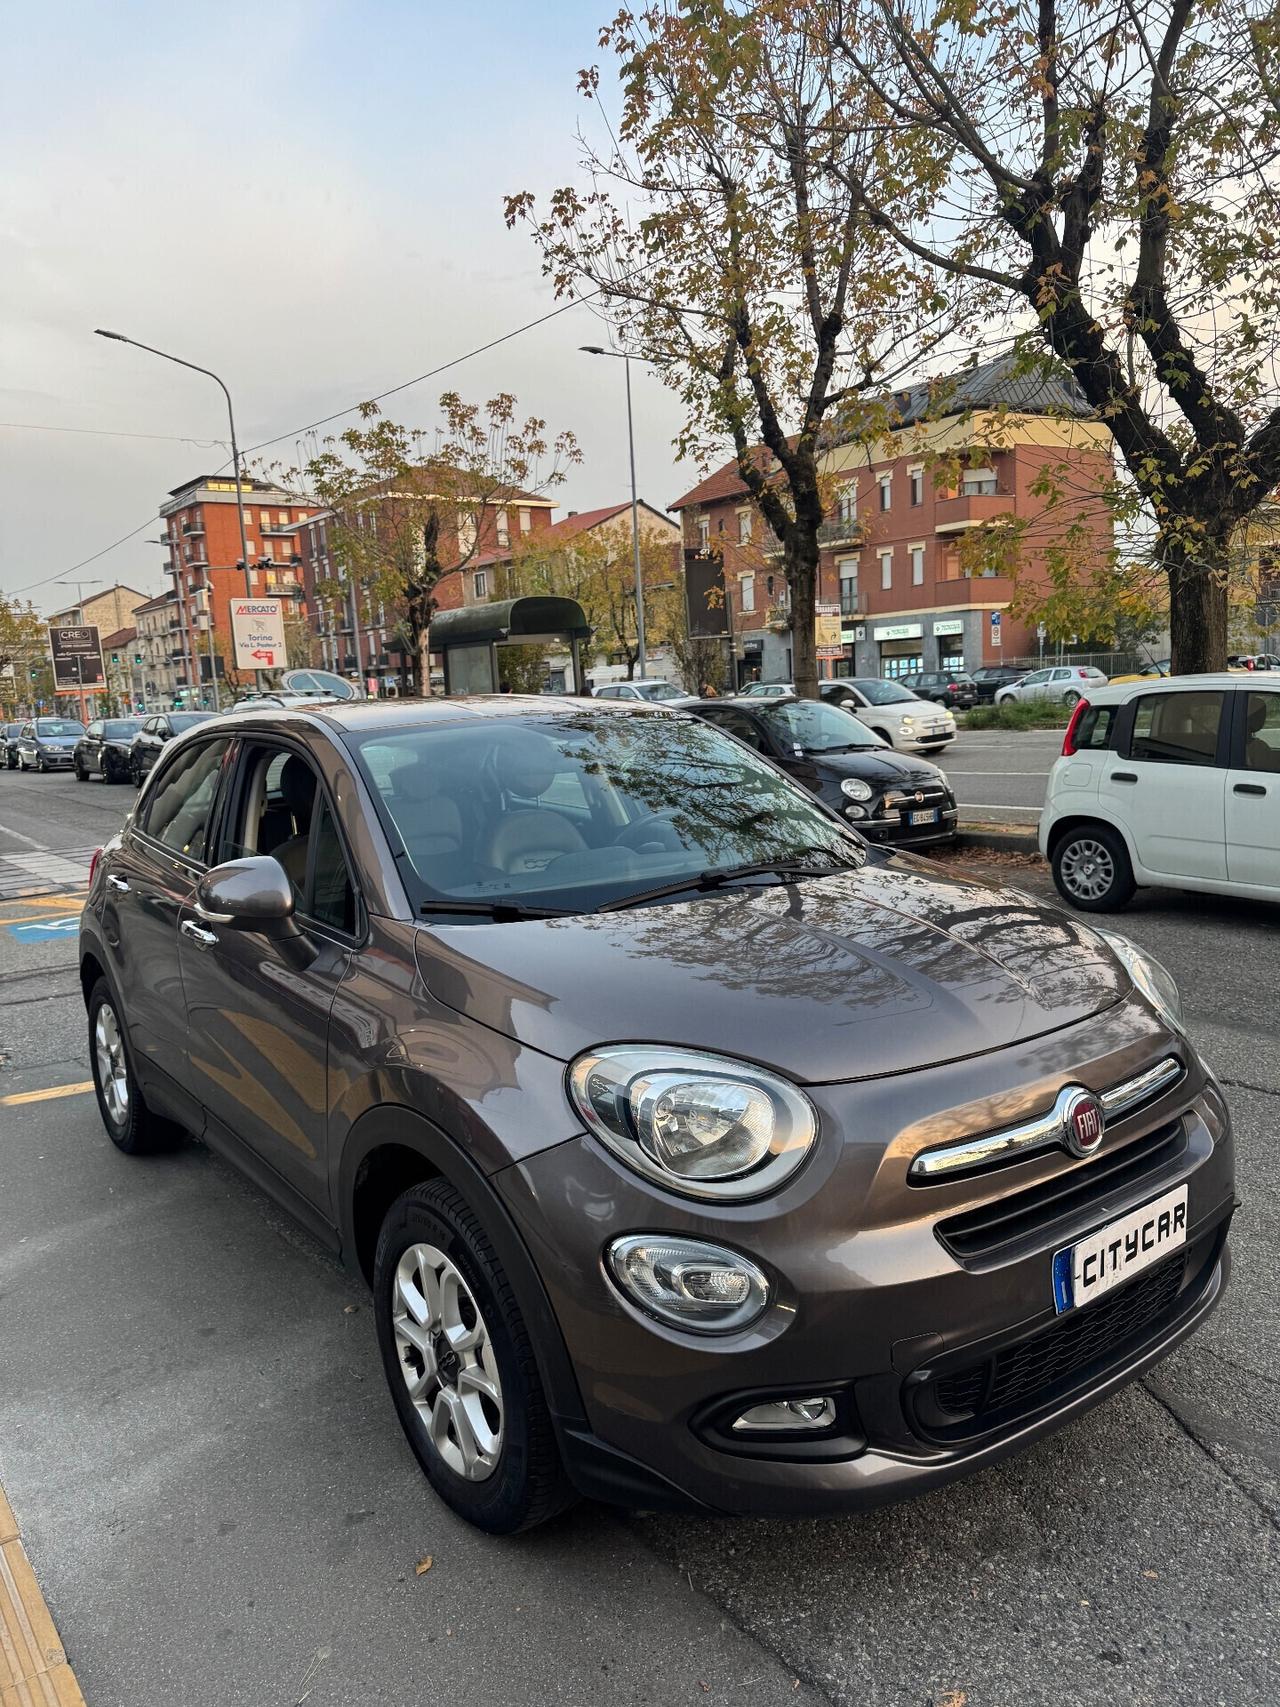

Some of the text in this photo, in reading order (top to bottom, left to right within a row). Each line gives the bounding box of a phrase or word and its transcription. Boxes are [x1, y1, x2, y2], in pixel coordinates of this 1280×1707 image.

[236, 605, 277, 615] MERCATO
[1077, 1109, 1098, 1139] FIAT
[1082, 1201, 1186, 1289] CITYCAR
